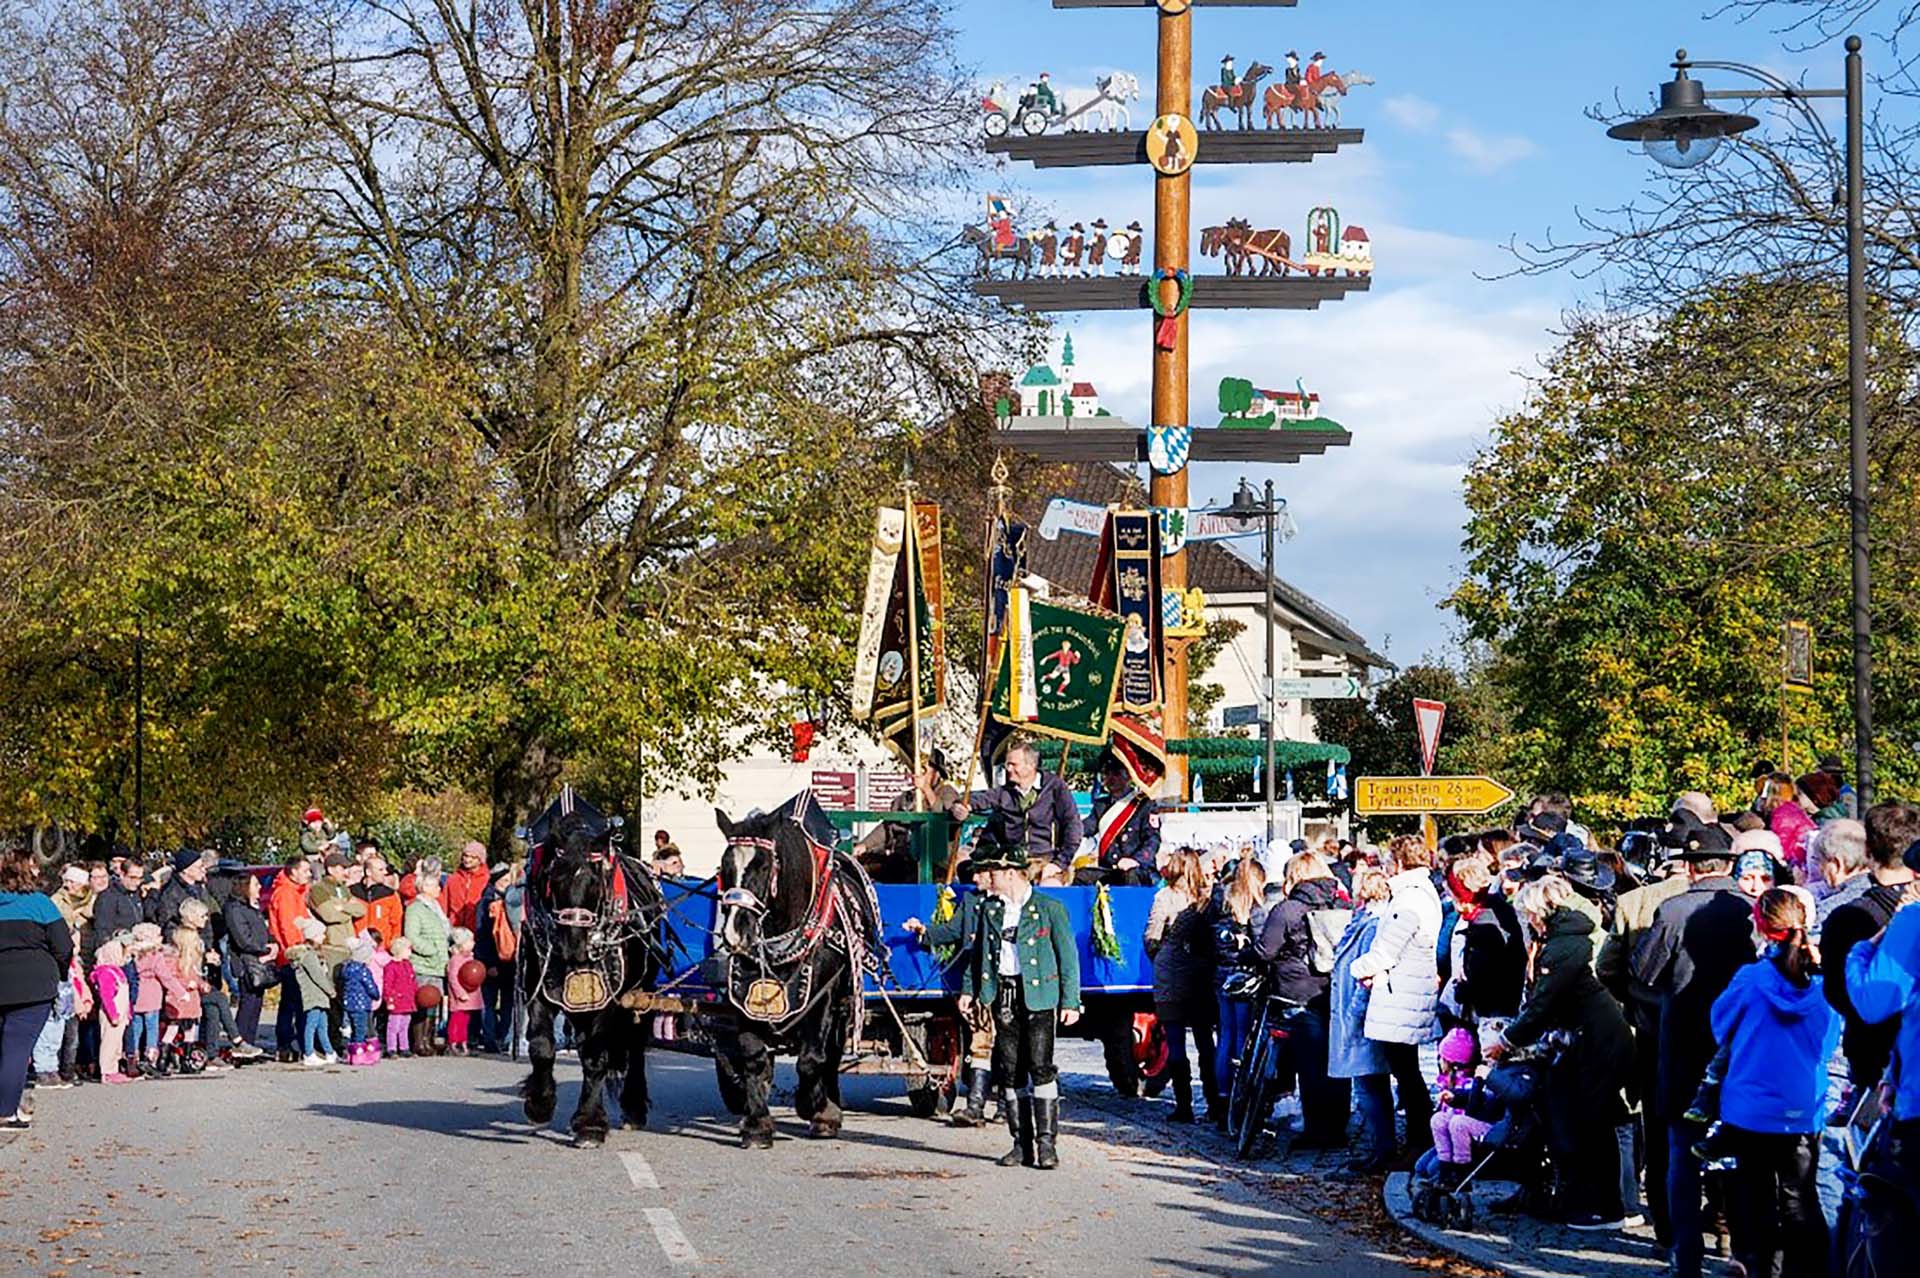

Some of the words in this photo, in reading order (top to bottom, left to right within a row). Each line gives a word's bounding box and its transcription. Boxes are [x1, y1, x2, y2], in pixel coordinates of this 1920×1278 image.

[1368, 783, 1440, 794] Traunstein
[1447, 782, 1462, 794] 26
[1368, 795, 1439, 810] Tyrlaching
[1455, 795, 1463, 806] 3
